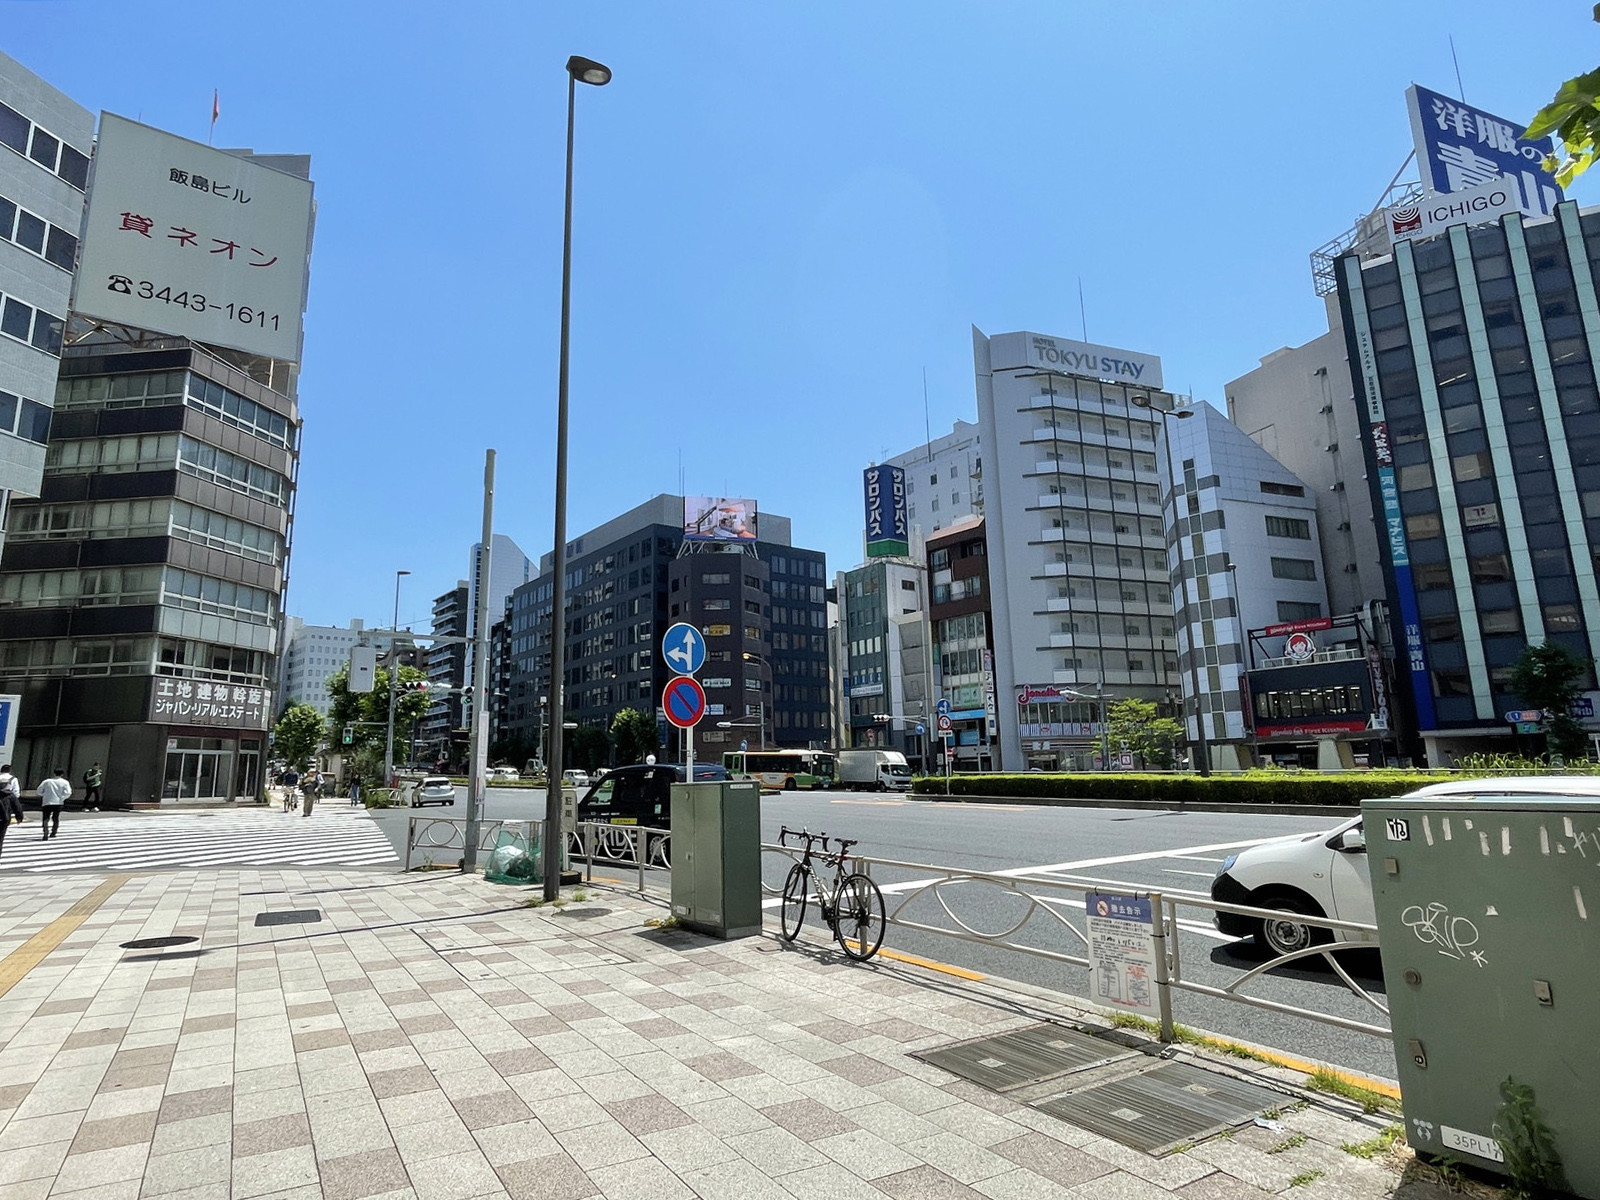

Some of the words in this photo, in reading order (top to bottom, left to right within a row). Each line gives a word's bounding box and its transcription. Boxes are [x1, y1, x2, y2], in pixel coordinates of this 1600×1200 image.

[168, 167, 252, 204] 飯島ビル
[1427, 191, 1507, 224] ICHIGO
[119, 211, 278, 267] 貸ネオン
[137, 280, 280, 331] 3443-1611
[1032, 337, 1056, 348] HOTEL
[1034, 344, 1098, 371] TOKYU
[1101, 357, 1144, 379] STAY
[867, 470, 882, 536] サロンパス
[892, 469, 906, 535] サロンパス
